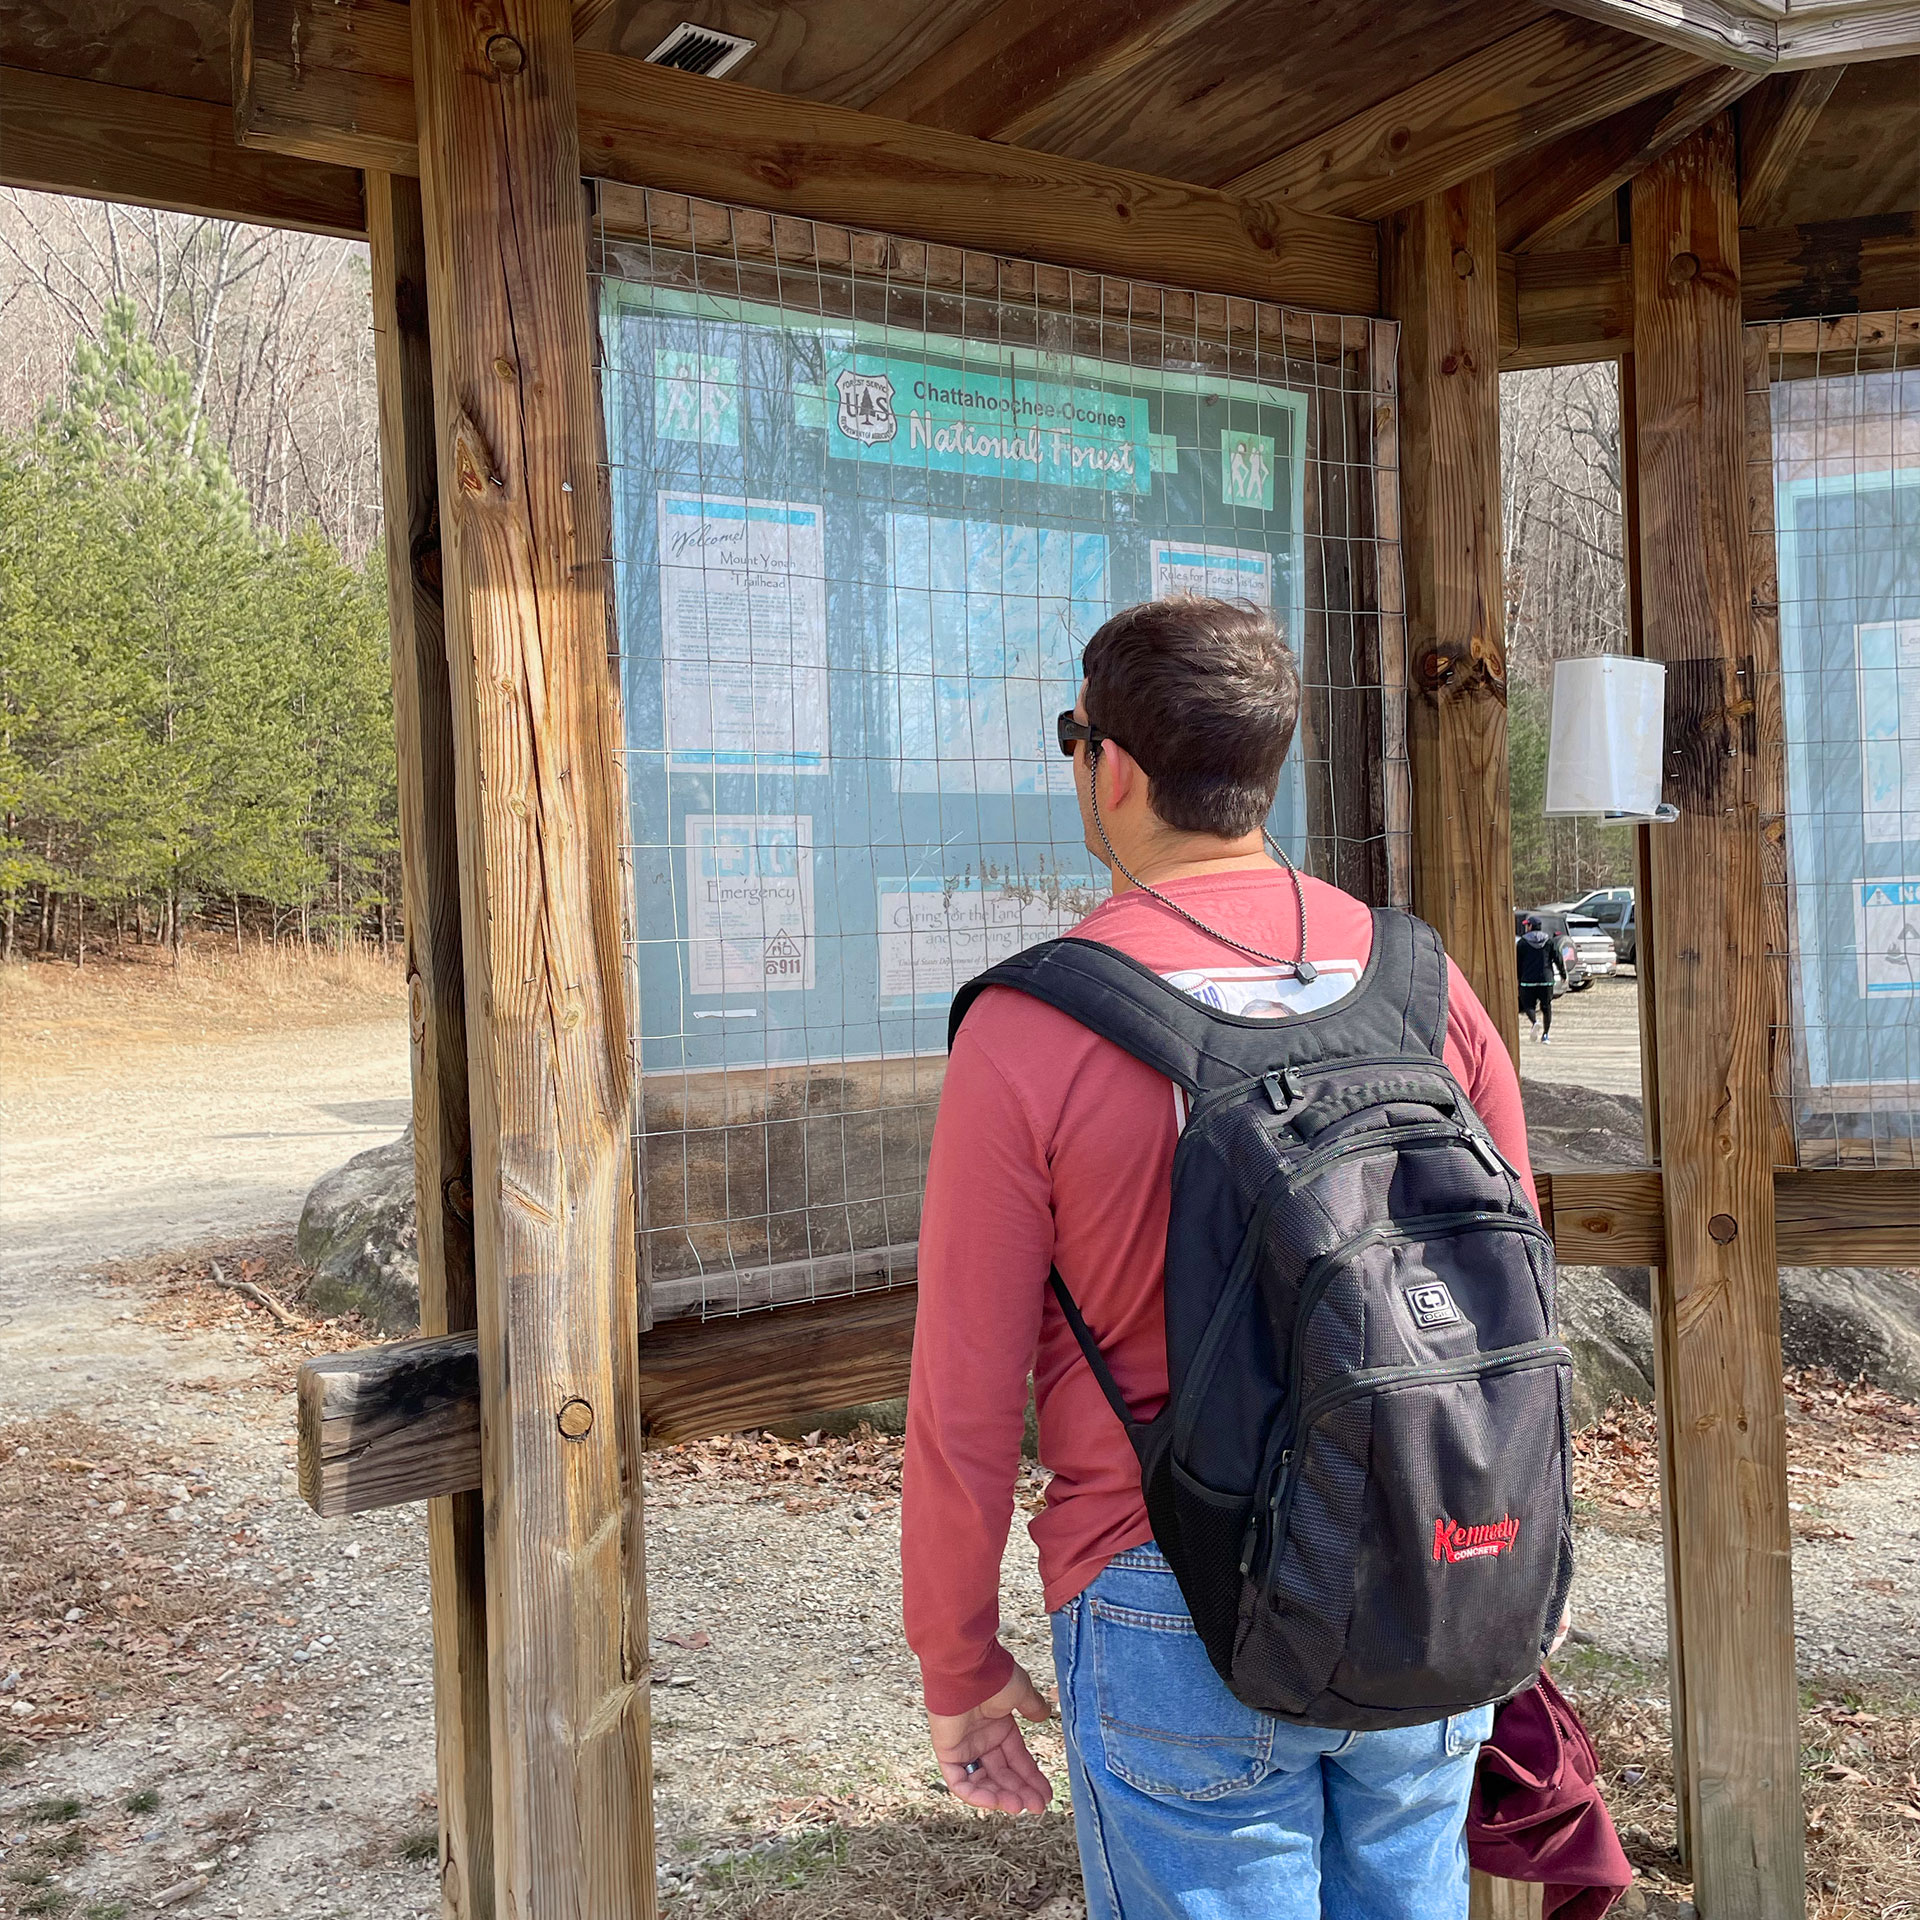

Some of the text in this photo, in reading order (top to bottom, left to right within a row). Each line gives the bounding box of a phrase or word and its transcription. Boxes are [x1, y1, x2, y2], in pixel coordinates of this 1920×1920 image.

[913, 380, 1127, 430] Chattahoochee-Oconee
[909, 408, 1136, 475] National Forest
[671, 523, 746, 558] Welcome!
[720, 551, 796, 568] Mount Yonah
[731, 571, 786, 589] Trailhead
[1160, 566, 1188, 582] Rules
[1189, 567, 1204, 583] for
[1205, 569, 1233, 585] Forest
[707, 880, 796, 905] Emergency
[893, 905, 943, 928] Caring
[969, 903, 989, 921] the
[992, 903, 1022, 924] Land
[925, 930, 950, 945] and
[955, 926, 1012, 948] Serving
[779, 958, 800, 974] 911
[1432, 1512, 1520, 1563] Kennedy
[1453, 1545, 1499, 1561] CONCRETE
